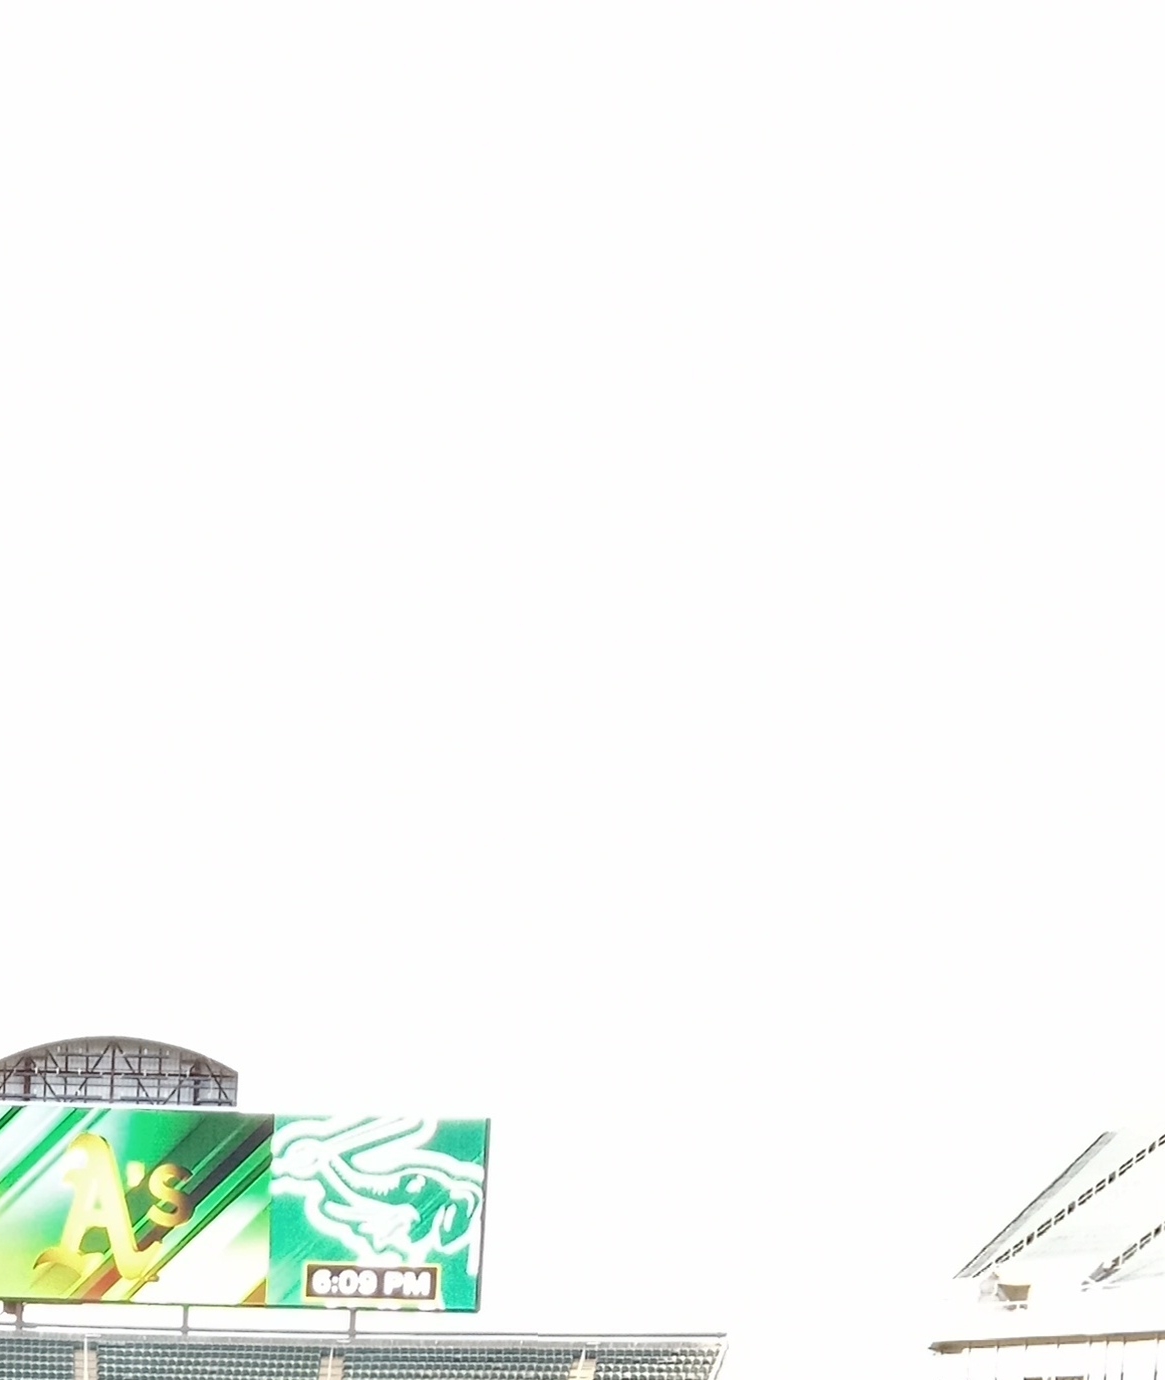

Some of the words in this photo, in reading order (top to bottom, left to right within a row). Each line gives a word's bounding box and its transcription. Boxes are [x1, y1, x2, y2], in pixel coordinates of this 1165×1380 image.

[33, 1131, 194, 1283] A's
[311, 1268, 378, 1296] 6:09
[383, 1270, 432, 1297] PM
